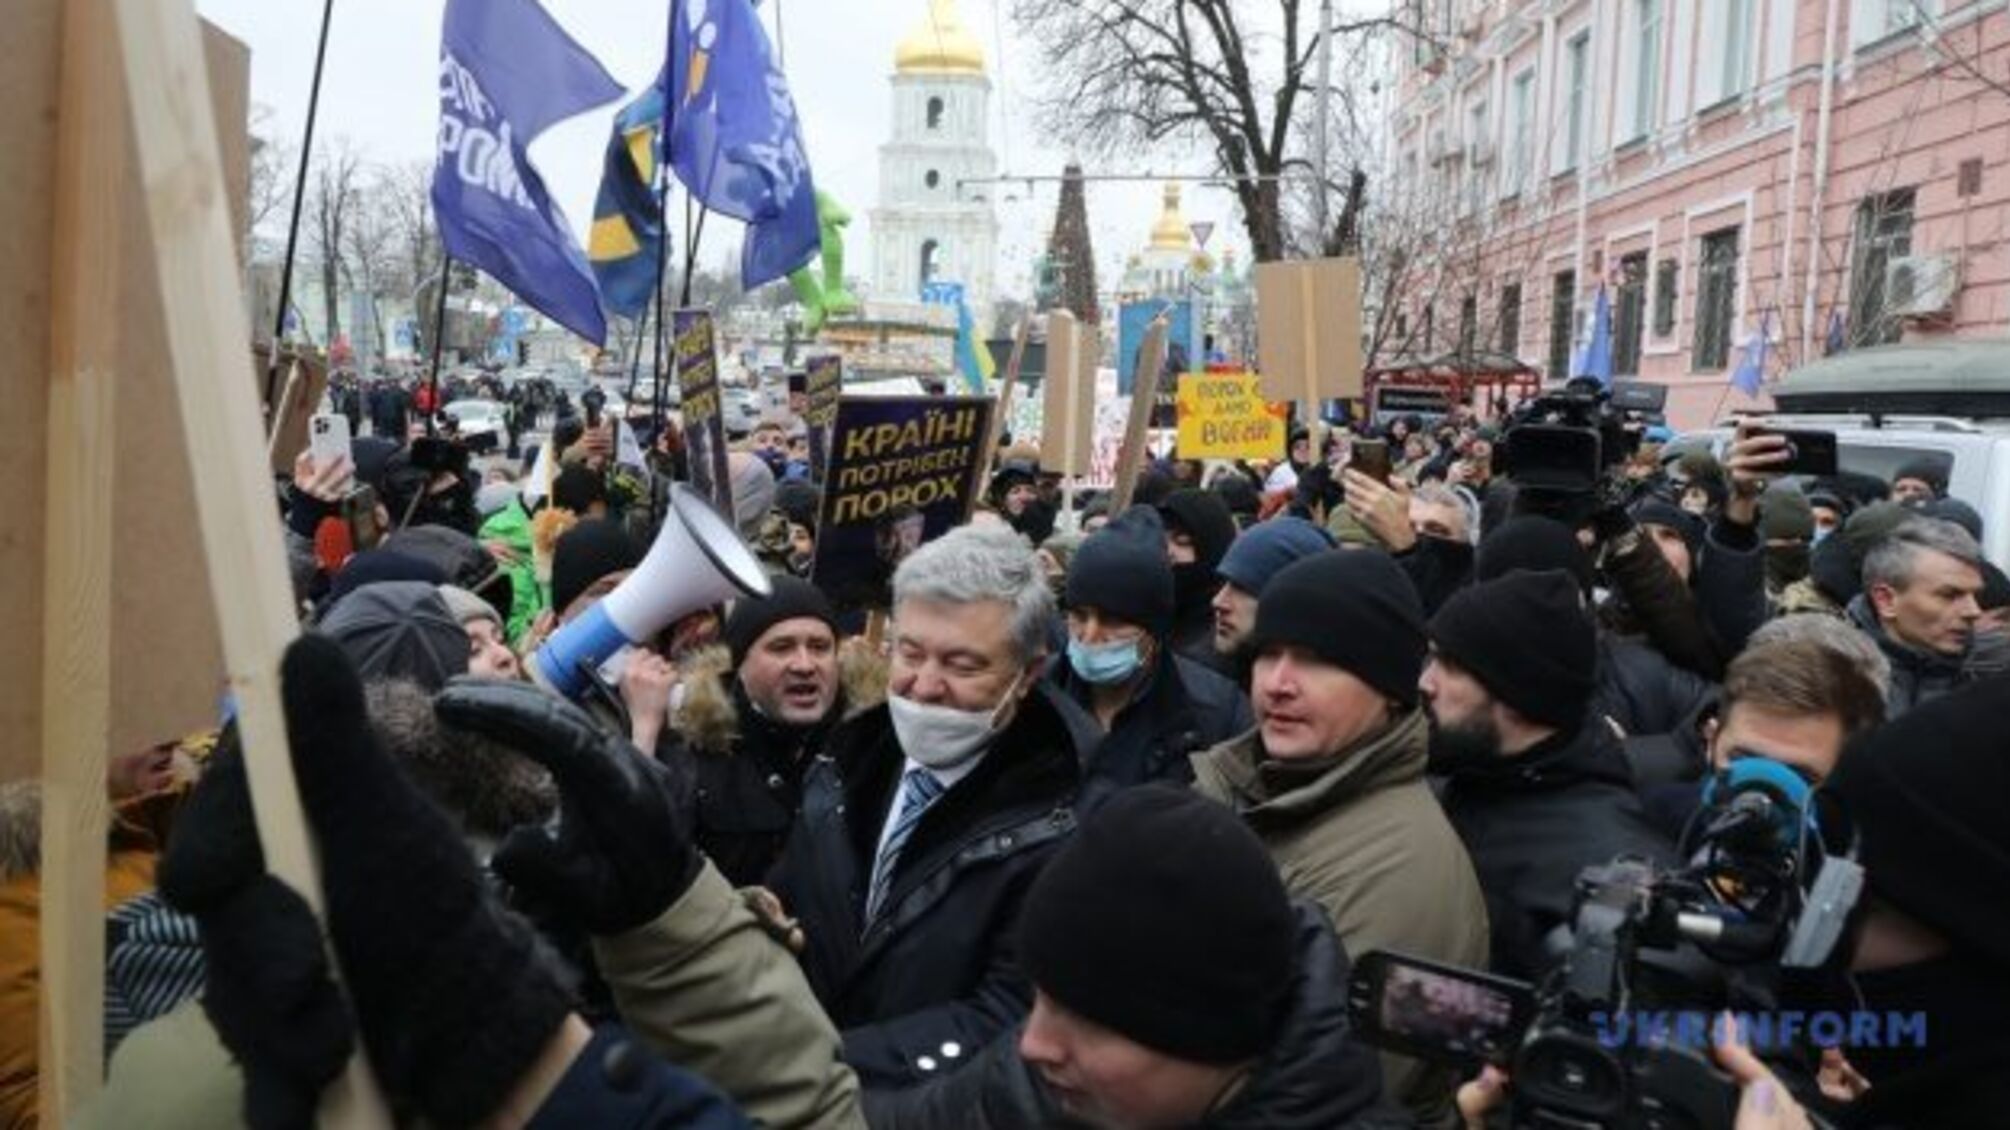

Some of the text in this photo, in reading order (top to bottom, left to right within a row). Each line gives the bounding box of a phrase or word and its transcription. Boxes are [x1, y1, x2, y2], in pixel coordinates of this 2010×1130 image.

[844, 408, 977, 461] КРАЇНІ
[839, 445, 970, 489] ПОТРІБЕН
[833, 471, 963, 526] ПОРОХ
